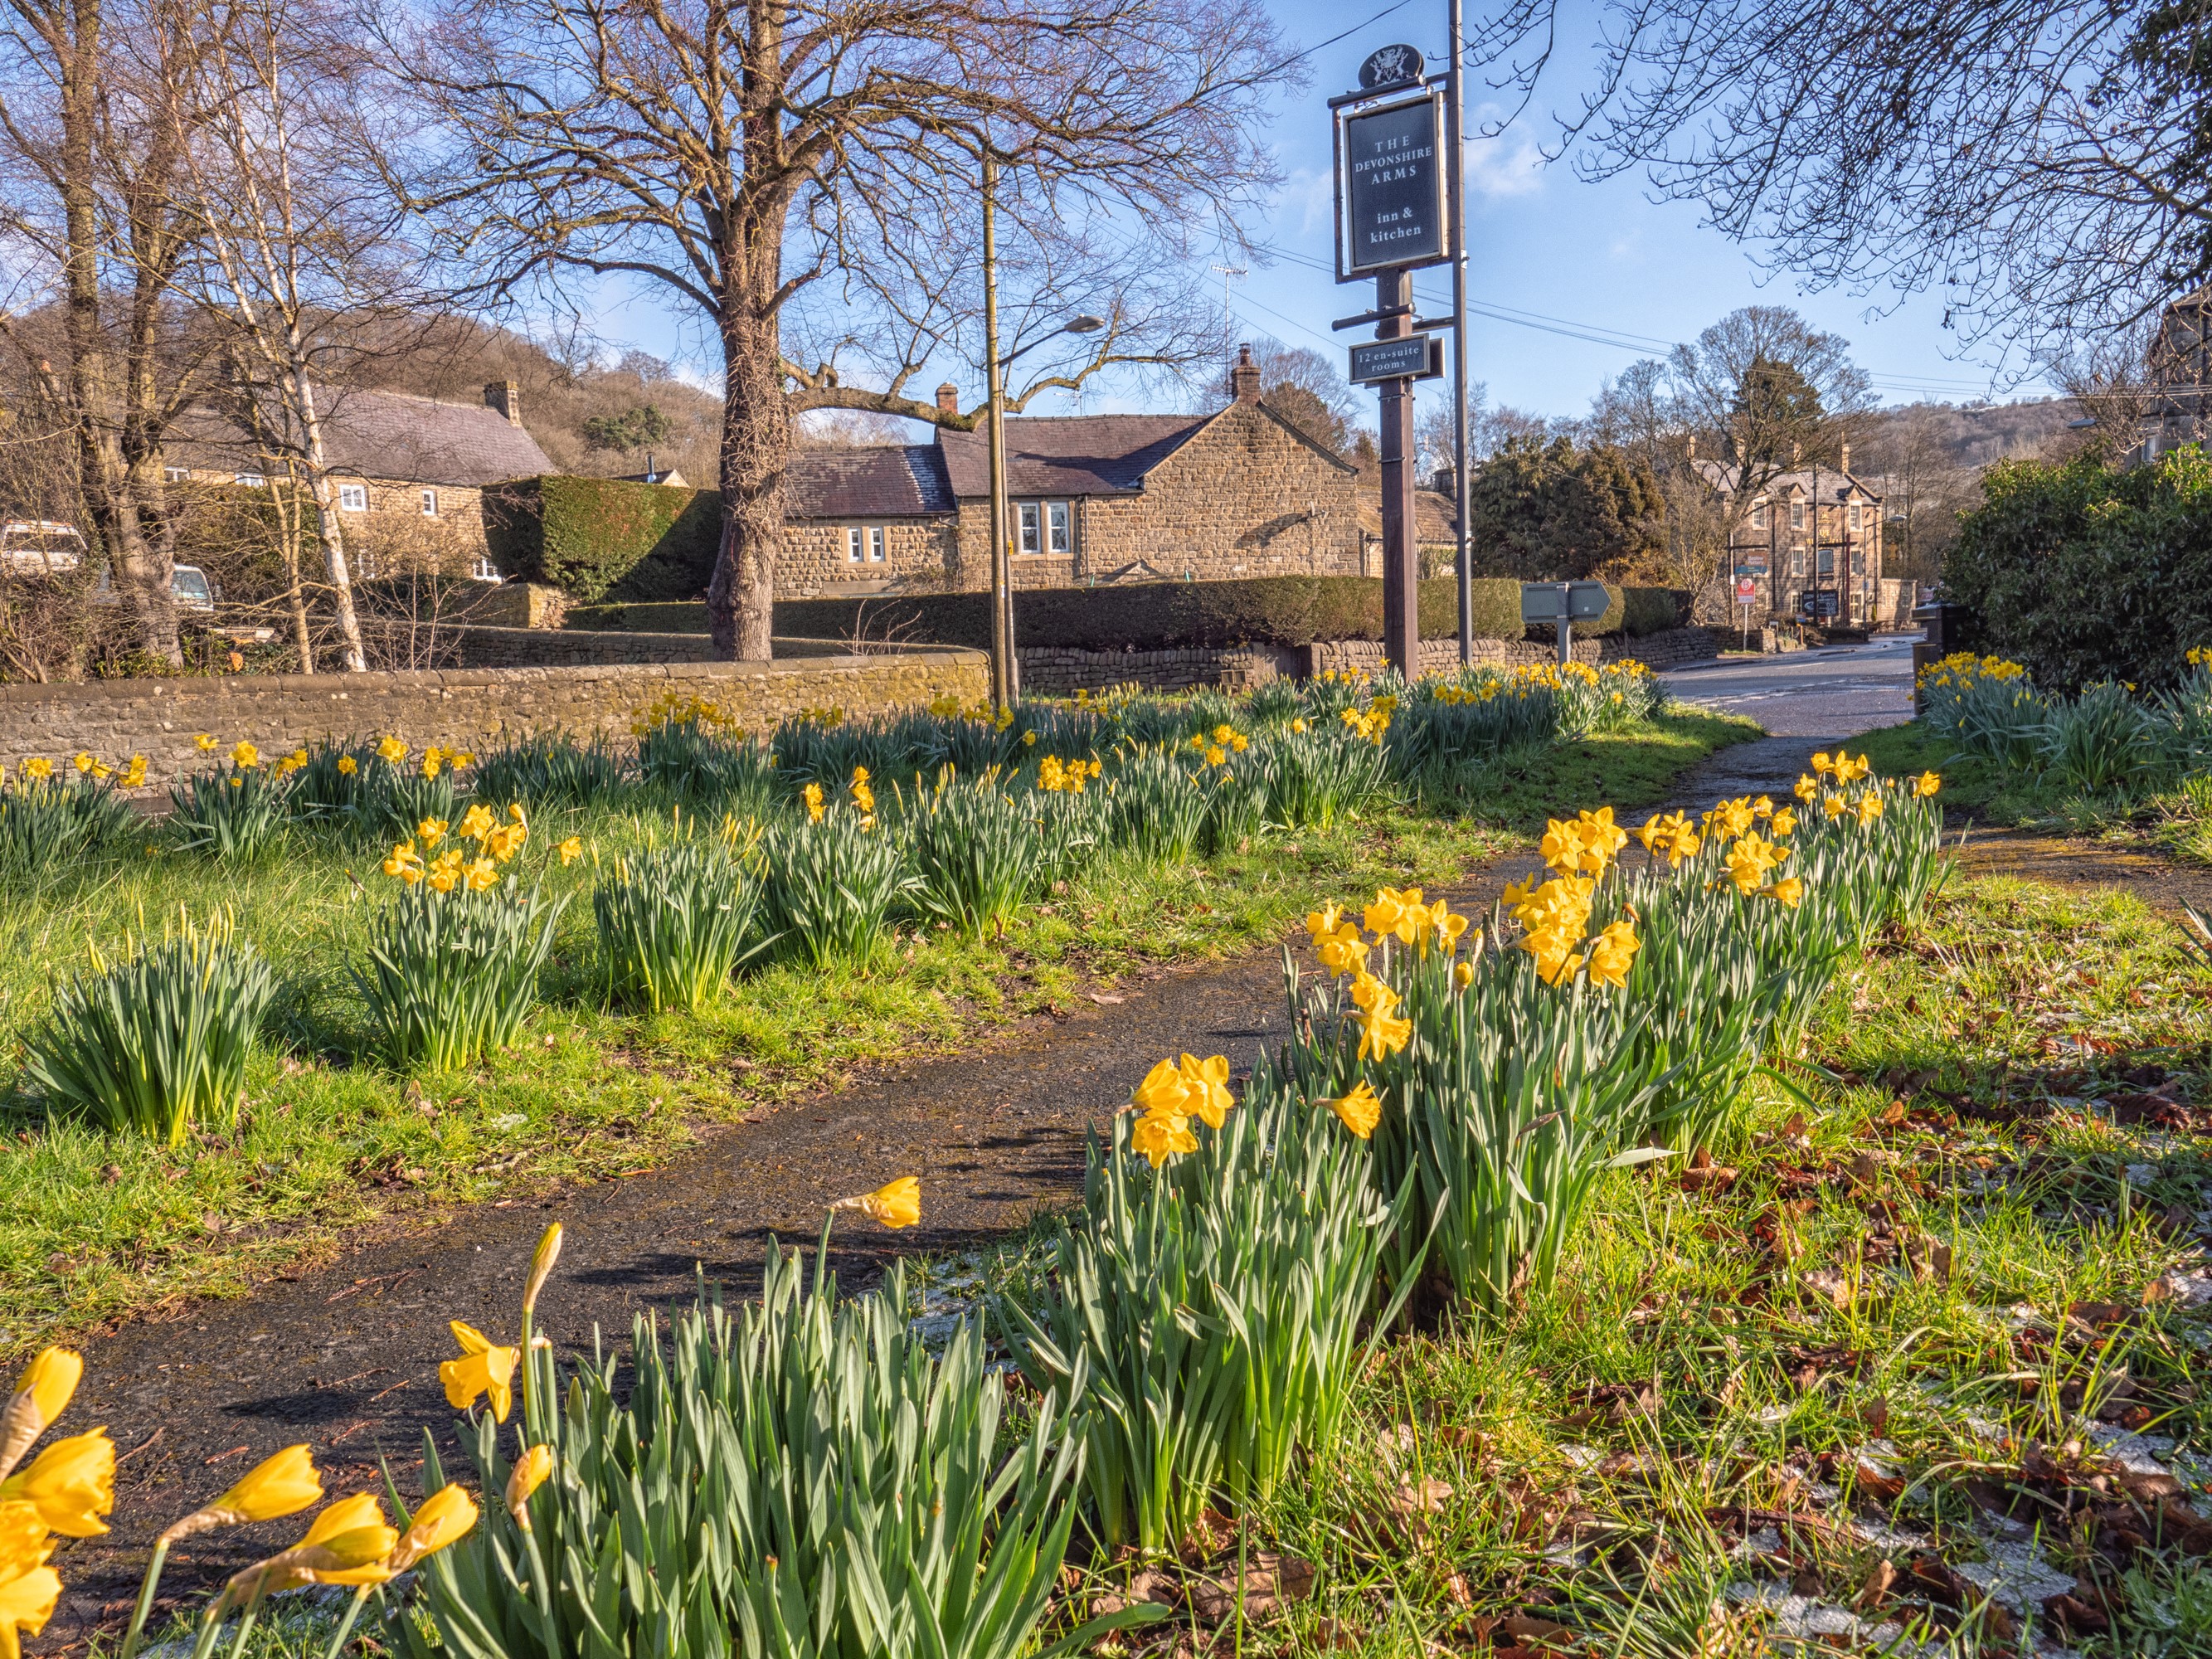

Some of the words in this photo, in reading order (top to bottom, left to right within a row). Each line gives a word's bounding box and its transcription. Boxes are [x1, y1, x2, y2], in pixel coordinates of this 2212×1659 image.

[1374, 135, 1410, 153] THE
[1355, 146, 1432, 173] DEVONSHIRE
[1371, 165, 1417, 185] ARMS
[1377, 212, 1399, 224] inn
[1402, 207, 1413, 219] &
[1370, 226, 1422, 244] kitchen
[1359, 353, 1371, 363] 12
[1373, 347, 1420, 361] en-suite
[1371, 360, 1406, 372] rooms
